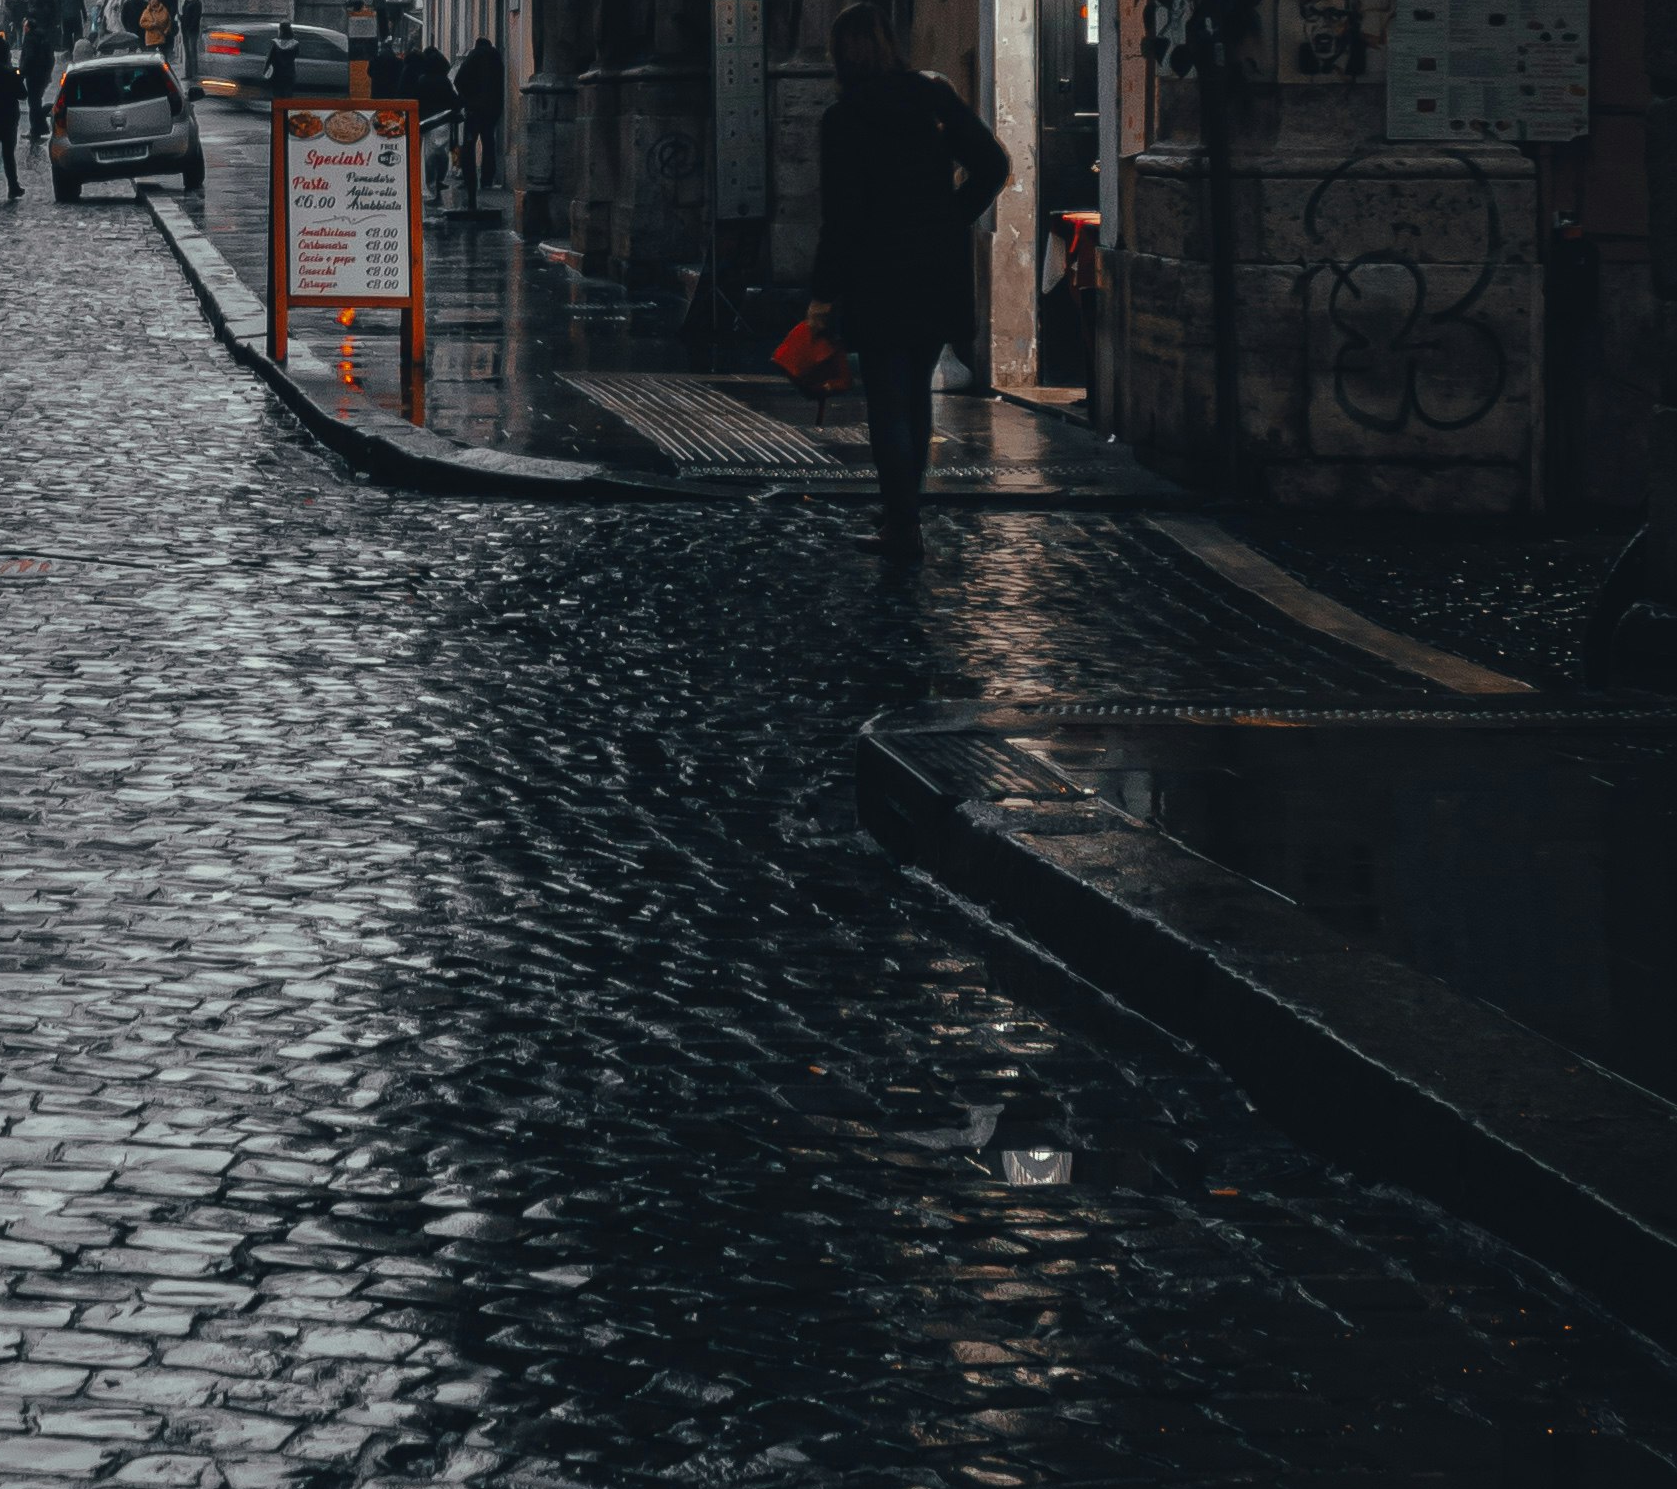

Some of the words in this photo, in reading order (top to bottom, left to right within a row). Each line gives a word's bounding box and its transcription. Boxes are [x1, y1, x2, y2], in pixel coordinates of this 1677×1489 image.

[305, 149, 372, 169] Specials!
[292, 176, 329, 190] Pasta
[346, 172, 395, 183] Pomodoro
[294, 195, 336, 209] €6.00
[346, 196, 402, 210] Arrabbiata
[298, 226, 356, 237] Amatriciana
[365, 228, 398, 238] €8.00
[298, 239, 348, 249] Carbonara
[365, 241, 399, 251] €8.00
[298, 252, 324, 262] Cacio
[333, 256, 356, 266] pepe
[366, 254, 399, 264] €8.00
[366, 267, 399, 277] €8.00
[366, 280, 399, 290] €8.00
